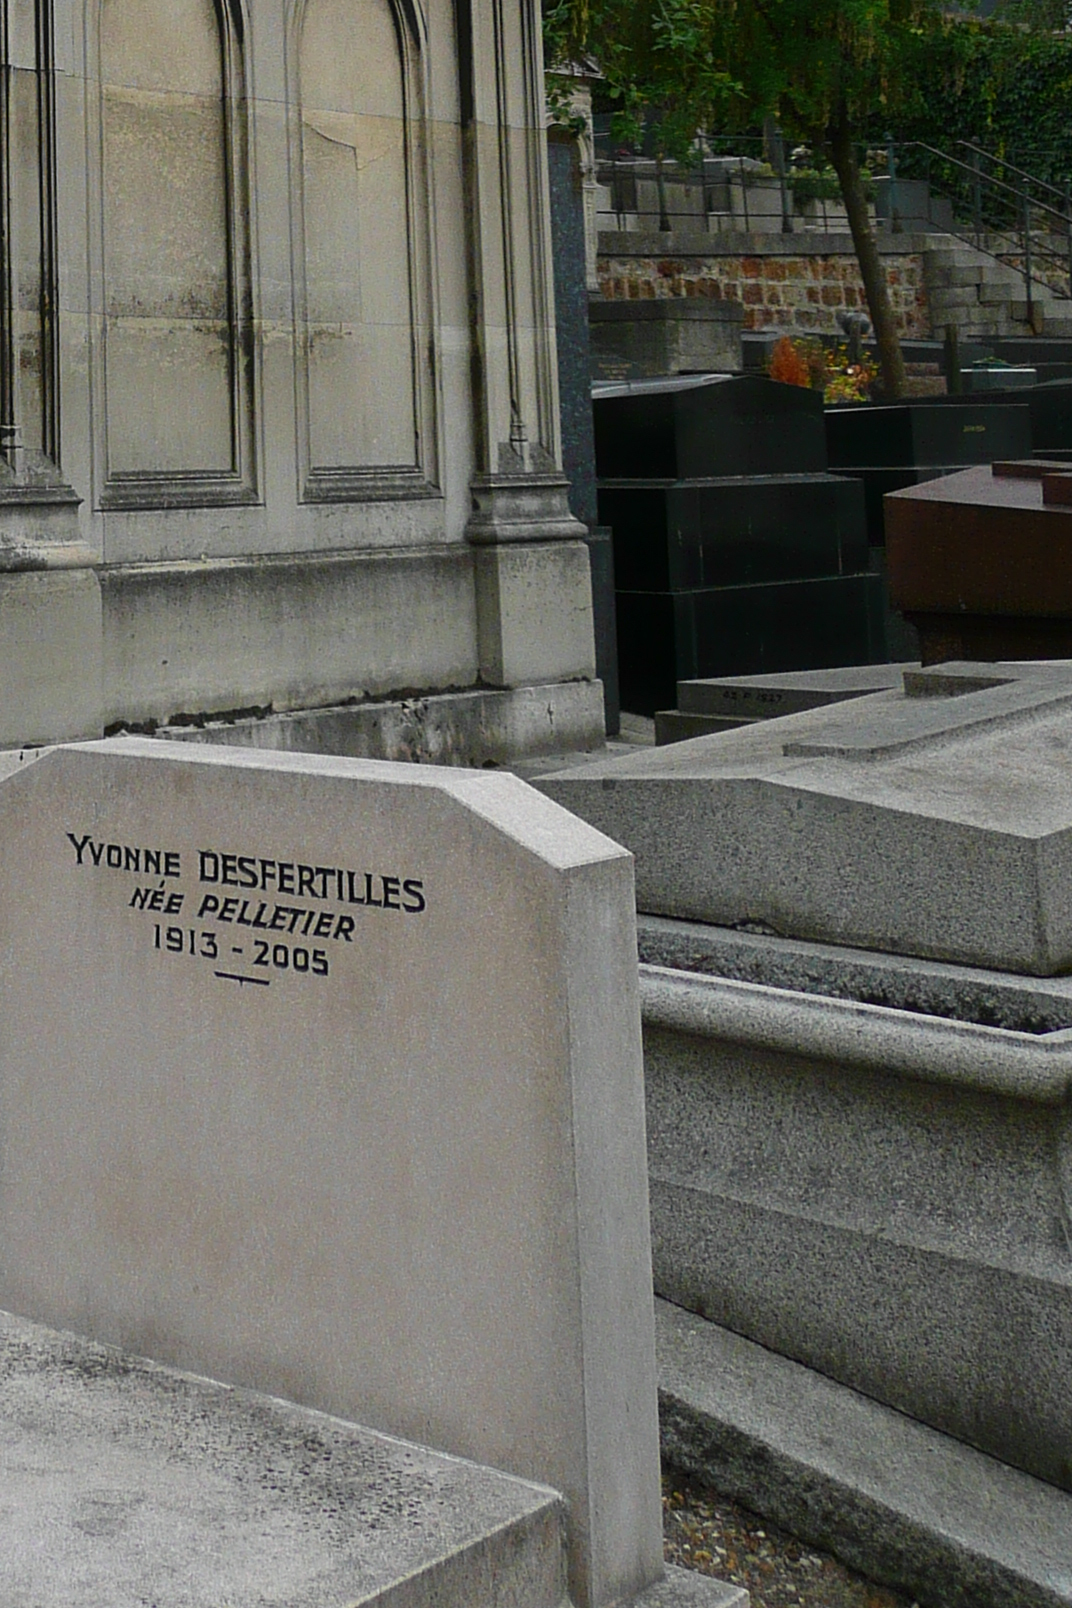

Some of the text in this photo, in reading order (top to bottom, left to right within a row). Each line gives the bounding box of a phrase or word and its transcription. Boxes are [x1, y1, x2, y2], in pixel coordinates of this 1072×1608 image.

[128, 879, 356, 943] NÉE PELLETIER
[196, 849, 426, 914] DESFERTILLES
[154, 924, 218, 960] 1913
[252, 939, 329, 977] 2005
